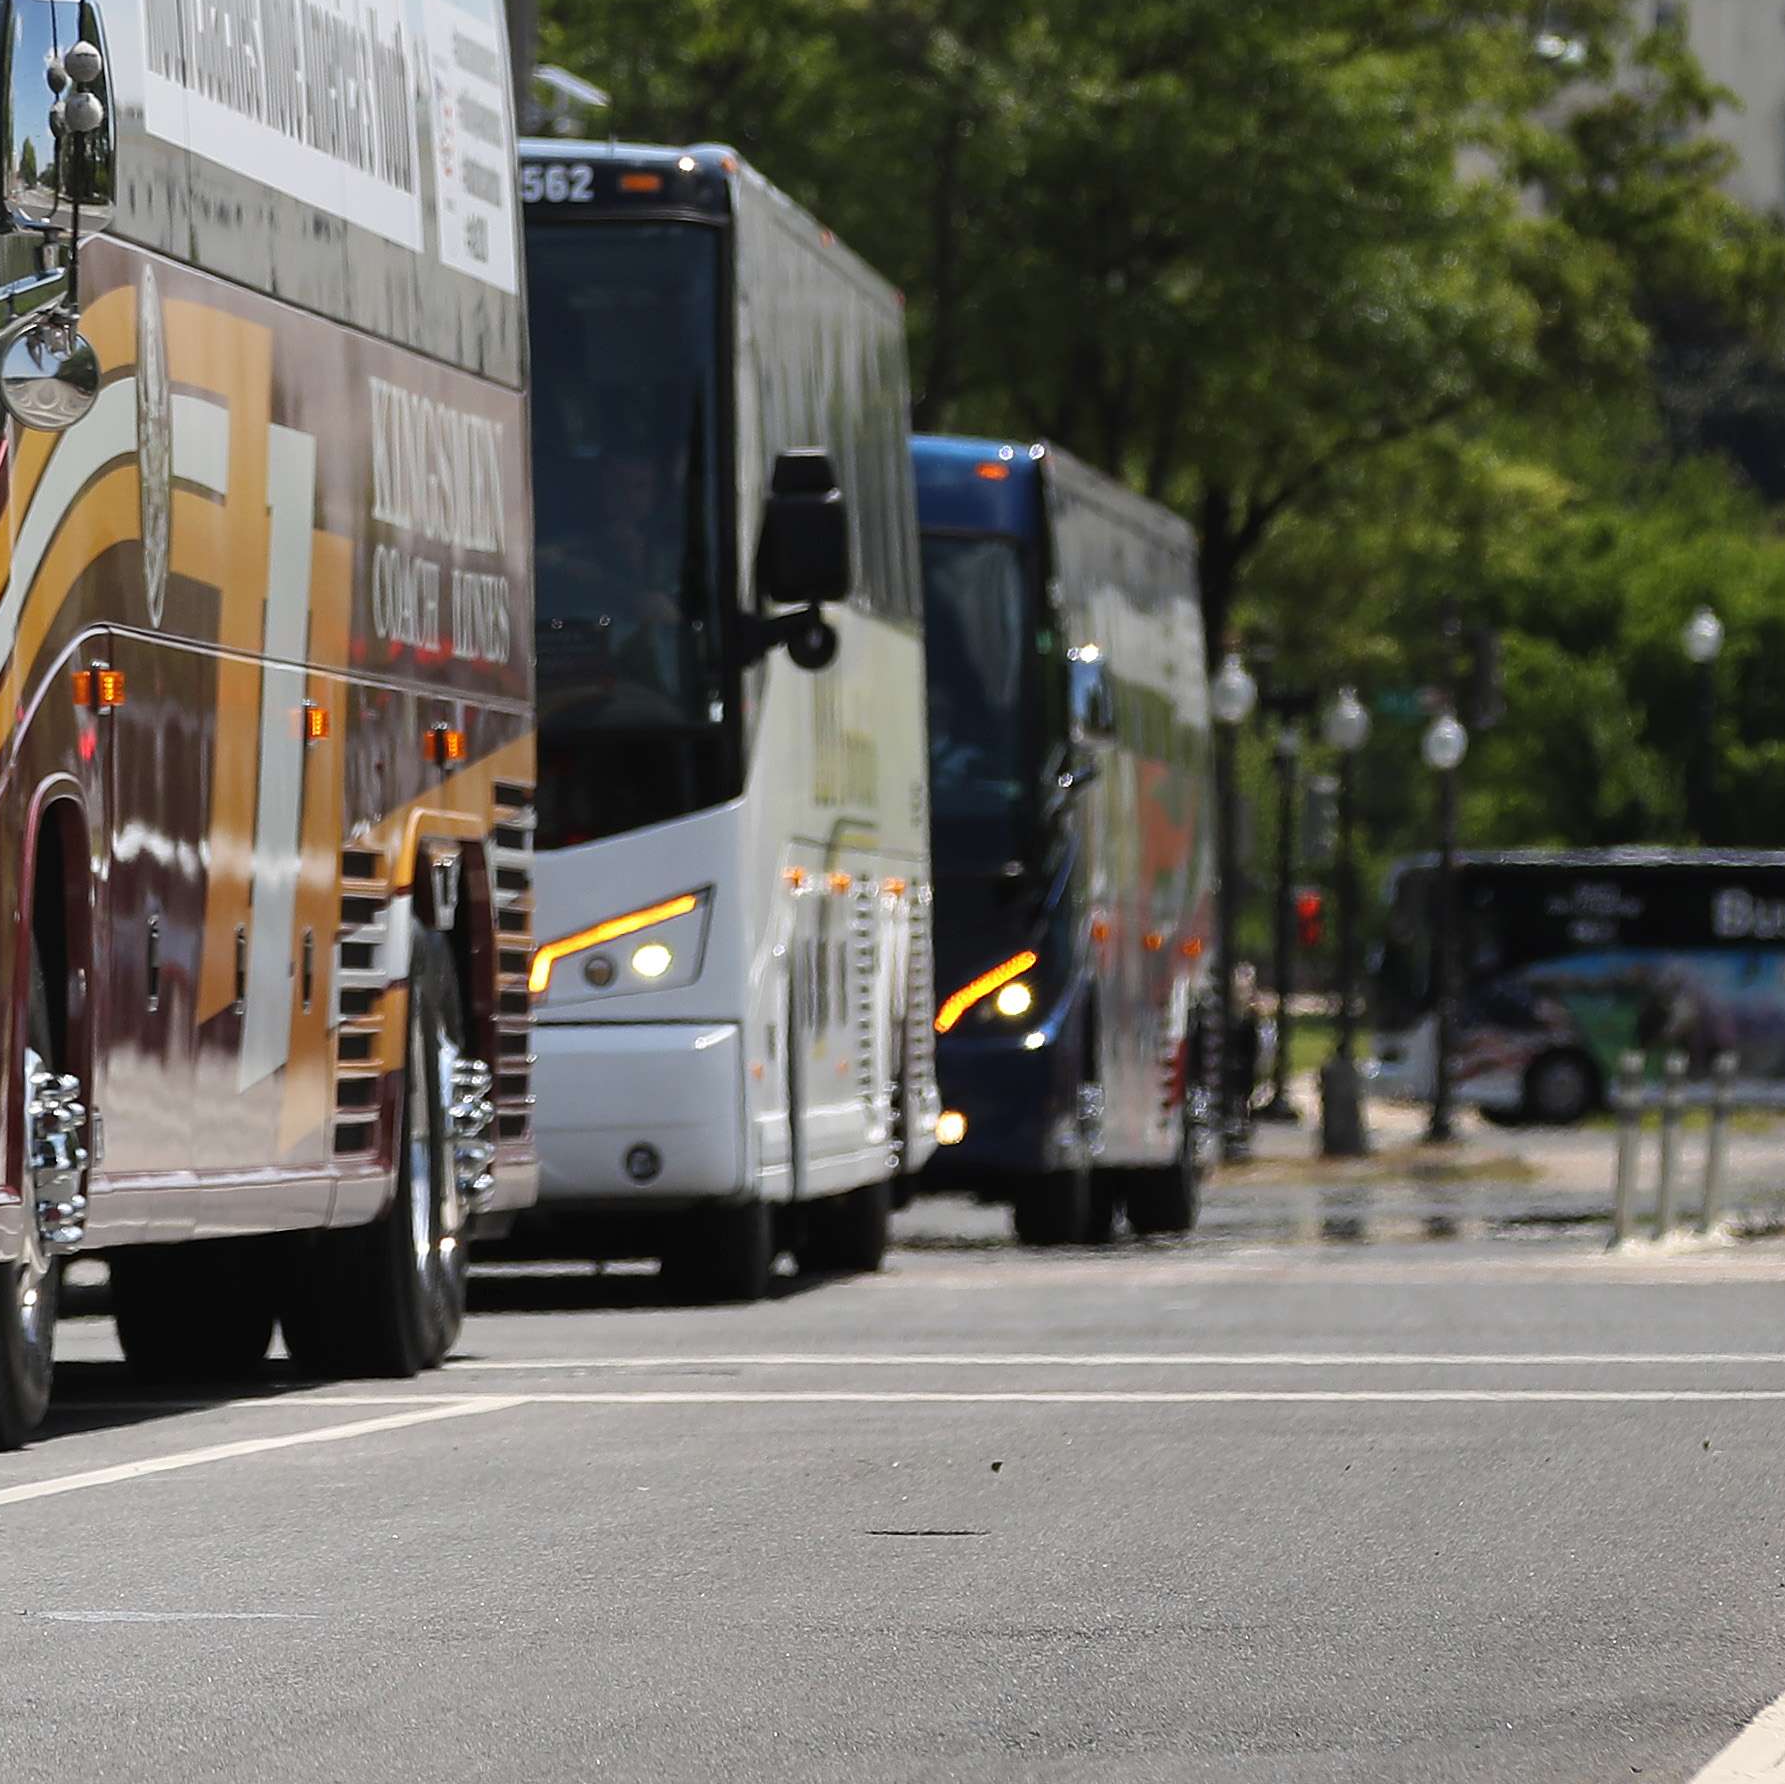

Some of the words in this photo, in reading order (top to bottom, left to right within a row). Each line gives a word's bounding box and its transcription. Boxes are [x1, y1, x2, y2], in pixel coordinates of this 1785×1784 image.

[368, 375, 506, 555] KINGSMEN
[373, 543, 441, 652] COACH
[452, 568, 511, 664] LINES
